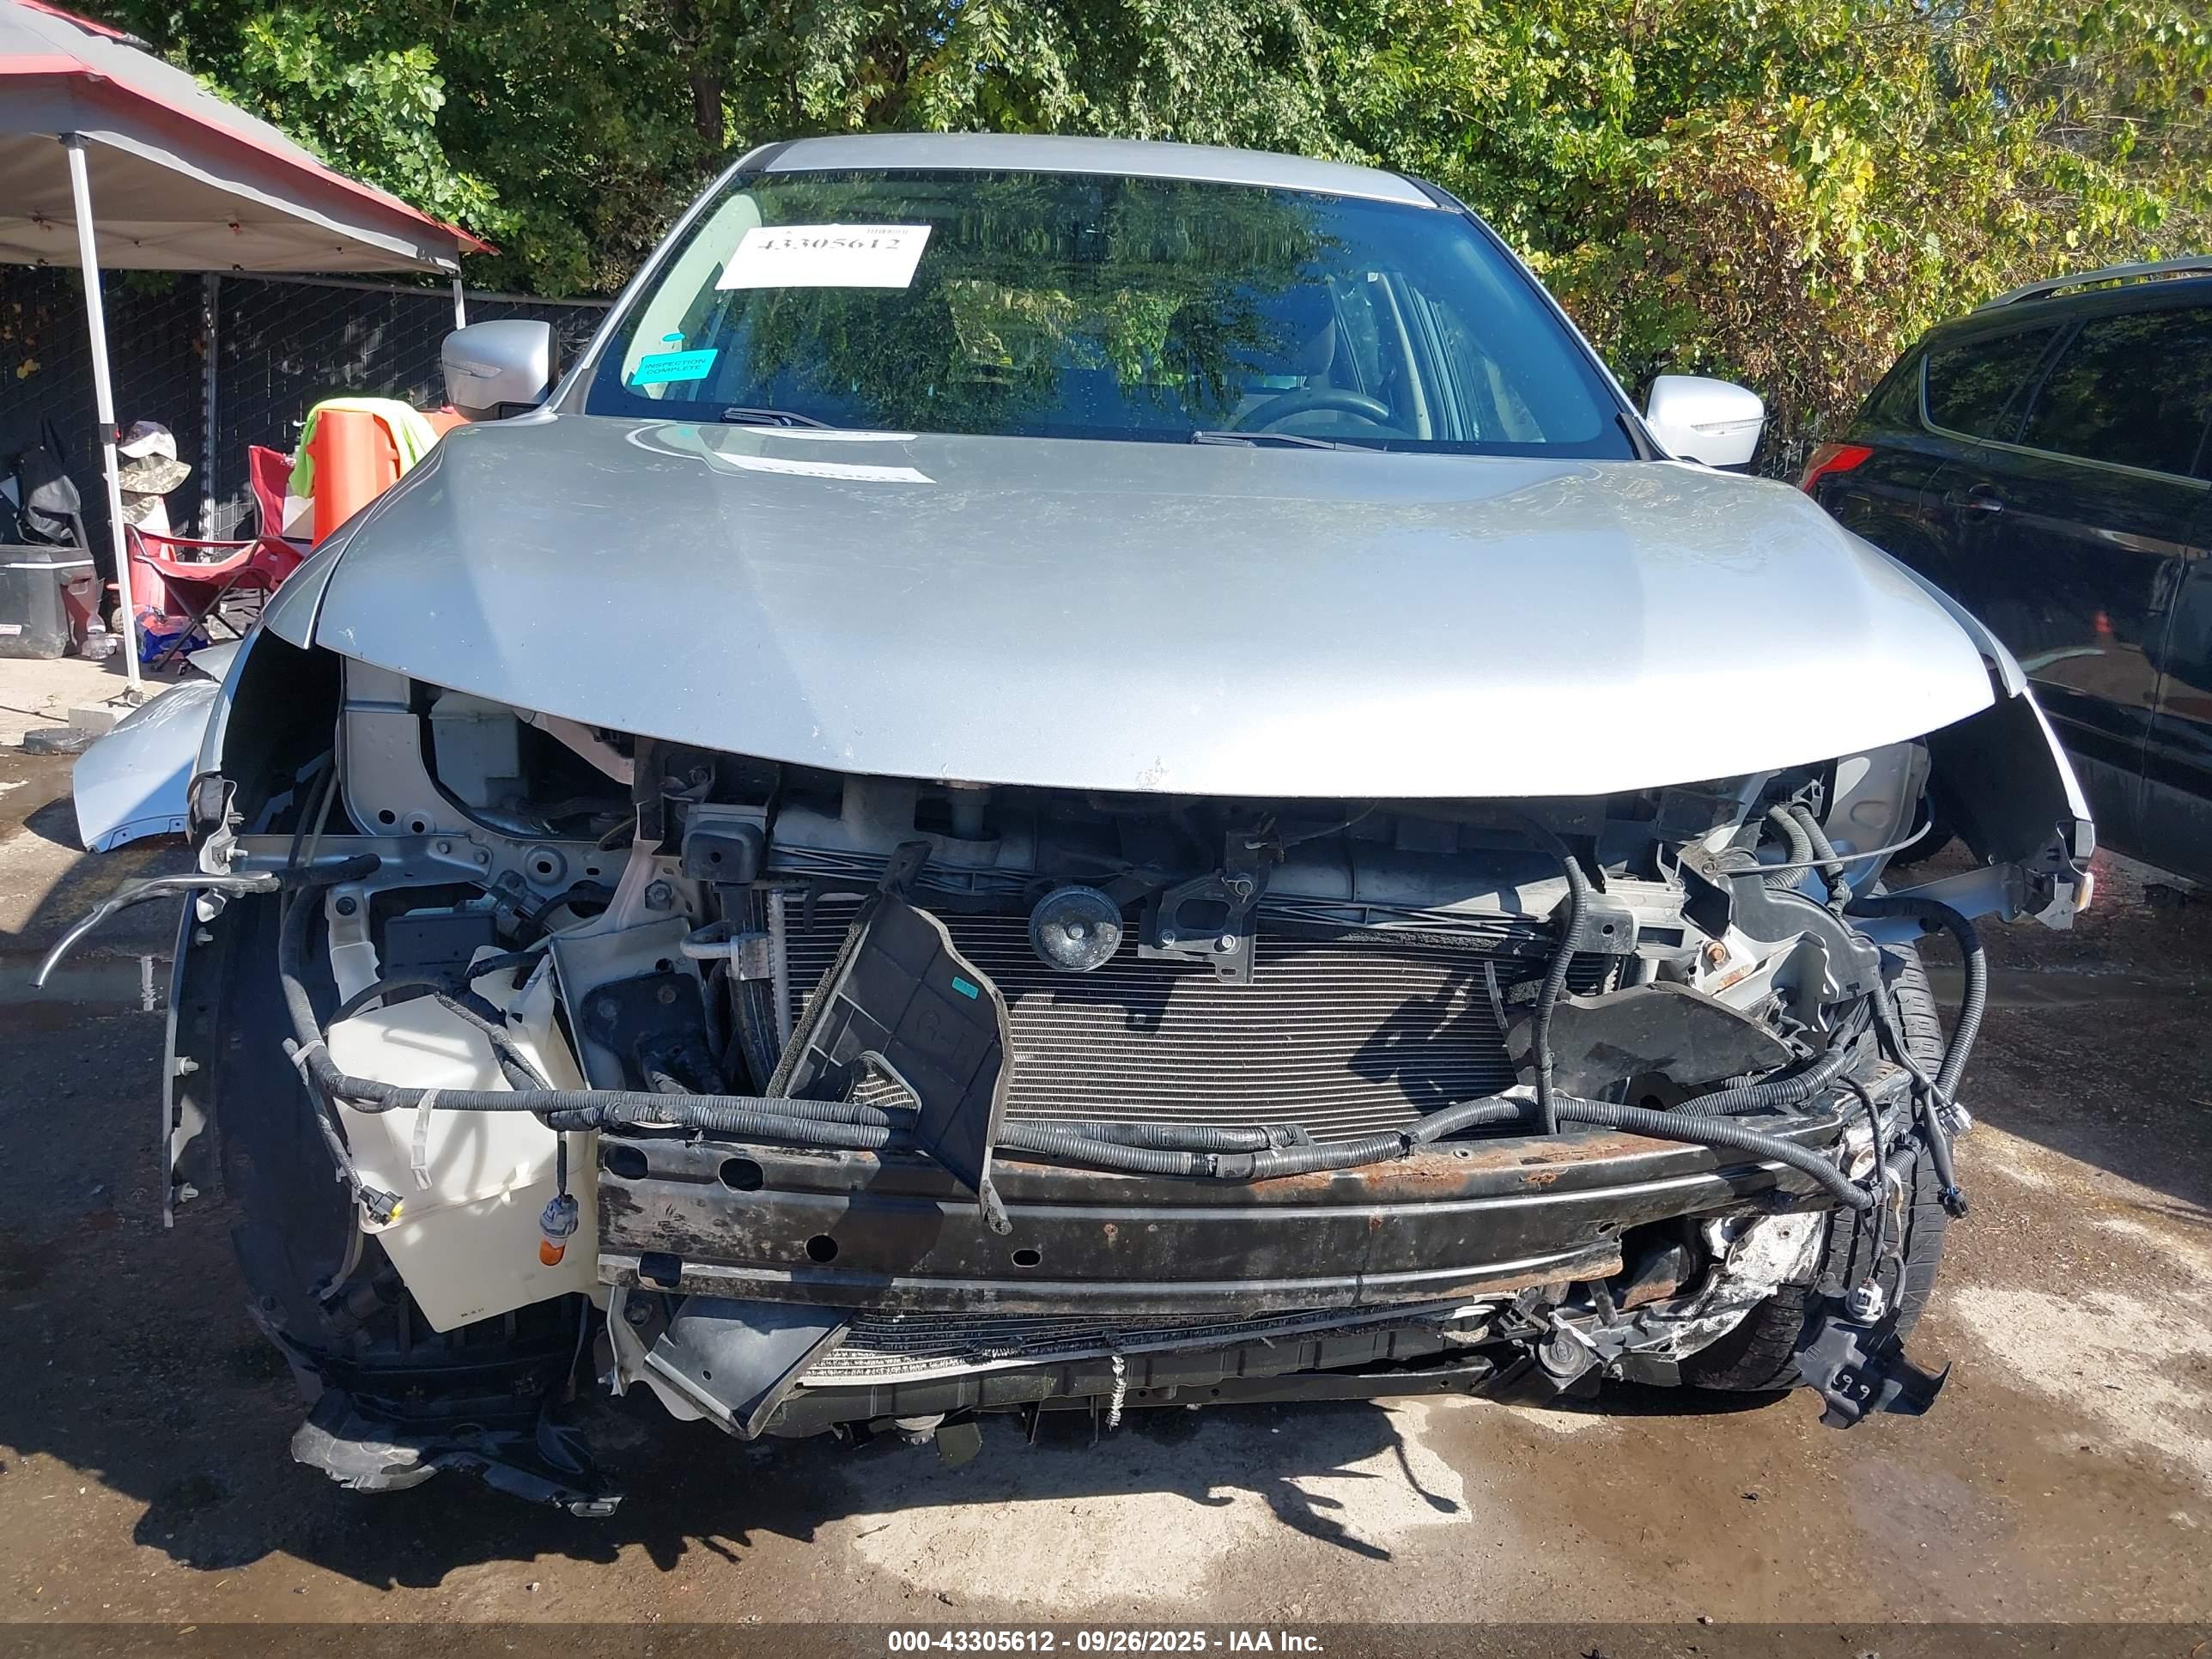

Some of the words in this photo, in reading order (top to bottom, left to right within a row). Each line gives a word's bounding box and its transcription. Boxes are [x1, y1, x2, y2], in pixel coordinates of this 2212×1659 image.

[757, 238, 900, 249] 43305612
[645, 358, 707, 369] INSPECTION
[646, 365, 702, 375] COMPLETE
